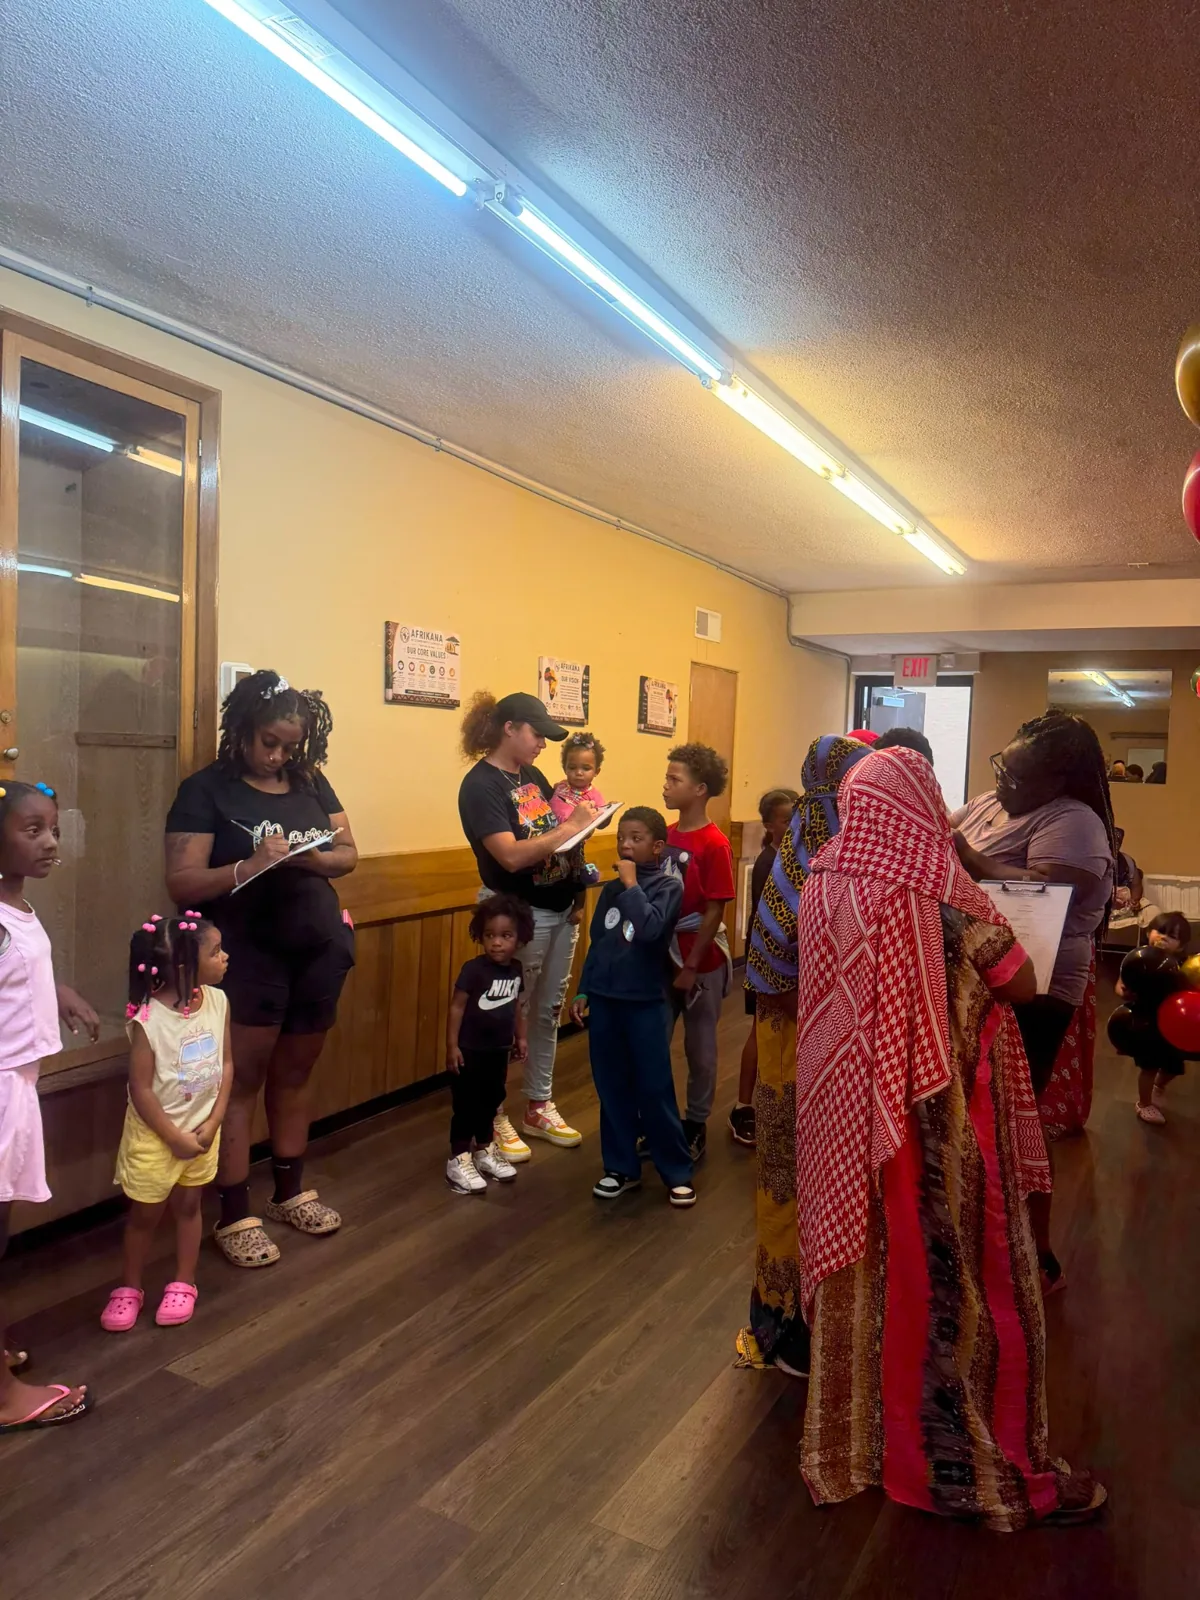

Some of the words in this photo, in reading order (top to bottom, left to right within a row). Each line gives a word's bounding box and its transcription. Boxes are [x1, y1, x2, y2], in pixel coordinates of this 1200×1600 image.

[411, 629, 443, 643] AFRIKANA
[407, 646, 417, 655] OUR
[417, 647, 429, 657] CORE
[430, 649, 446, 659] VALUES
[902, 657, 929, 678] EXIT
